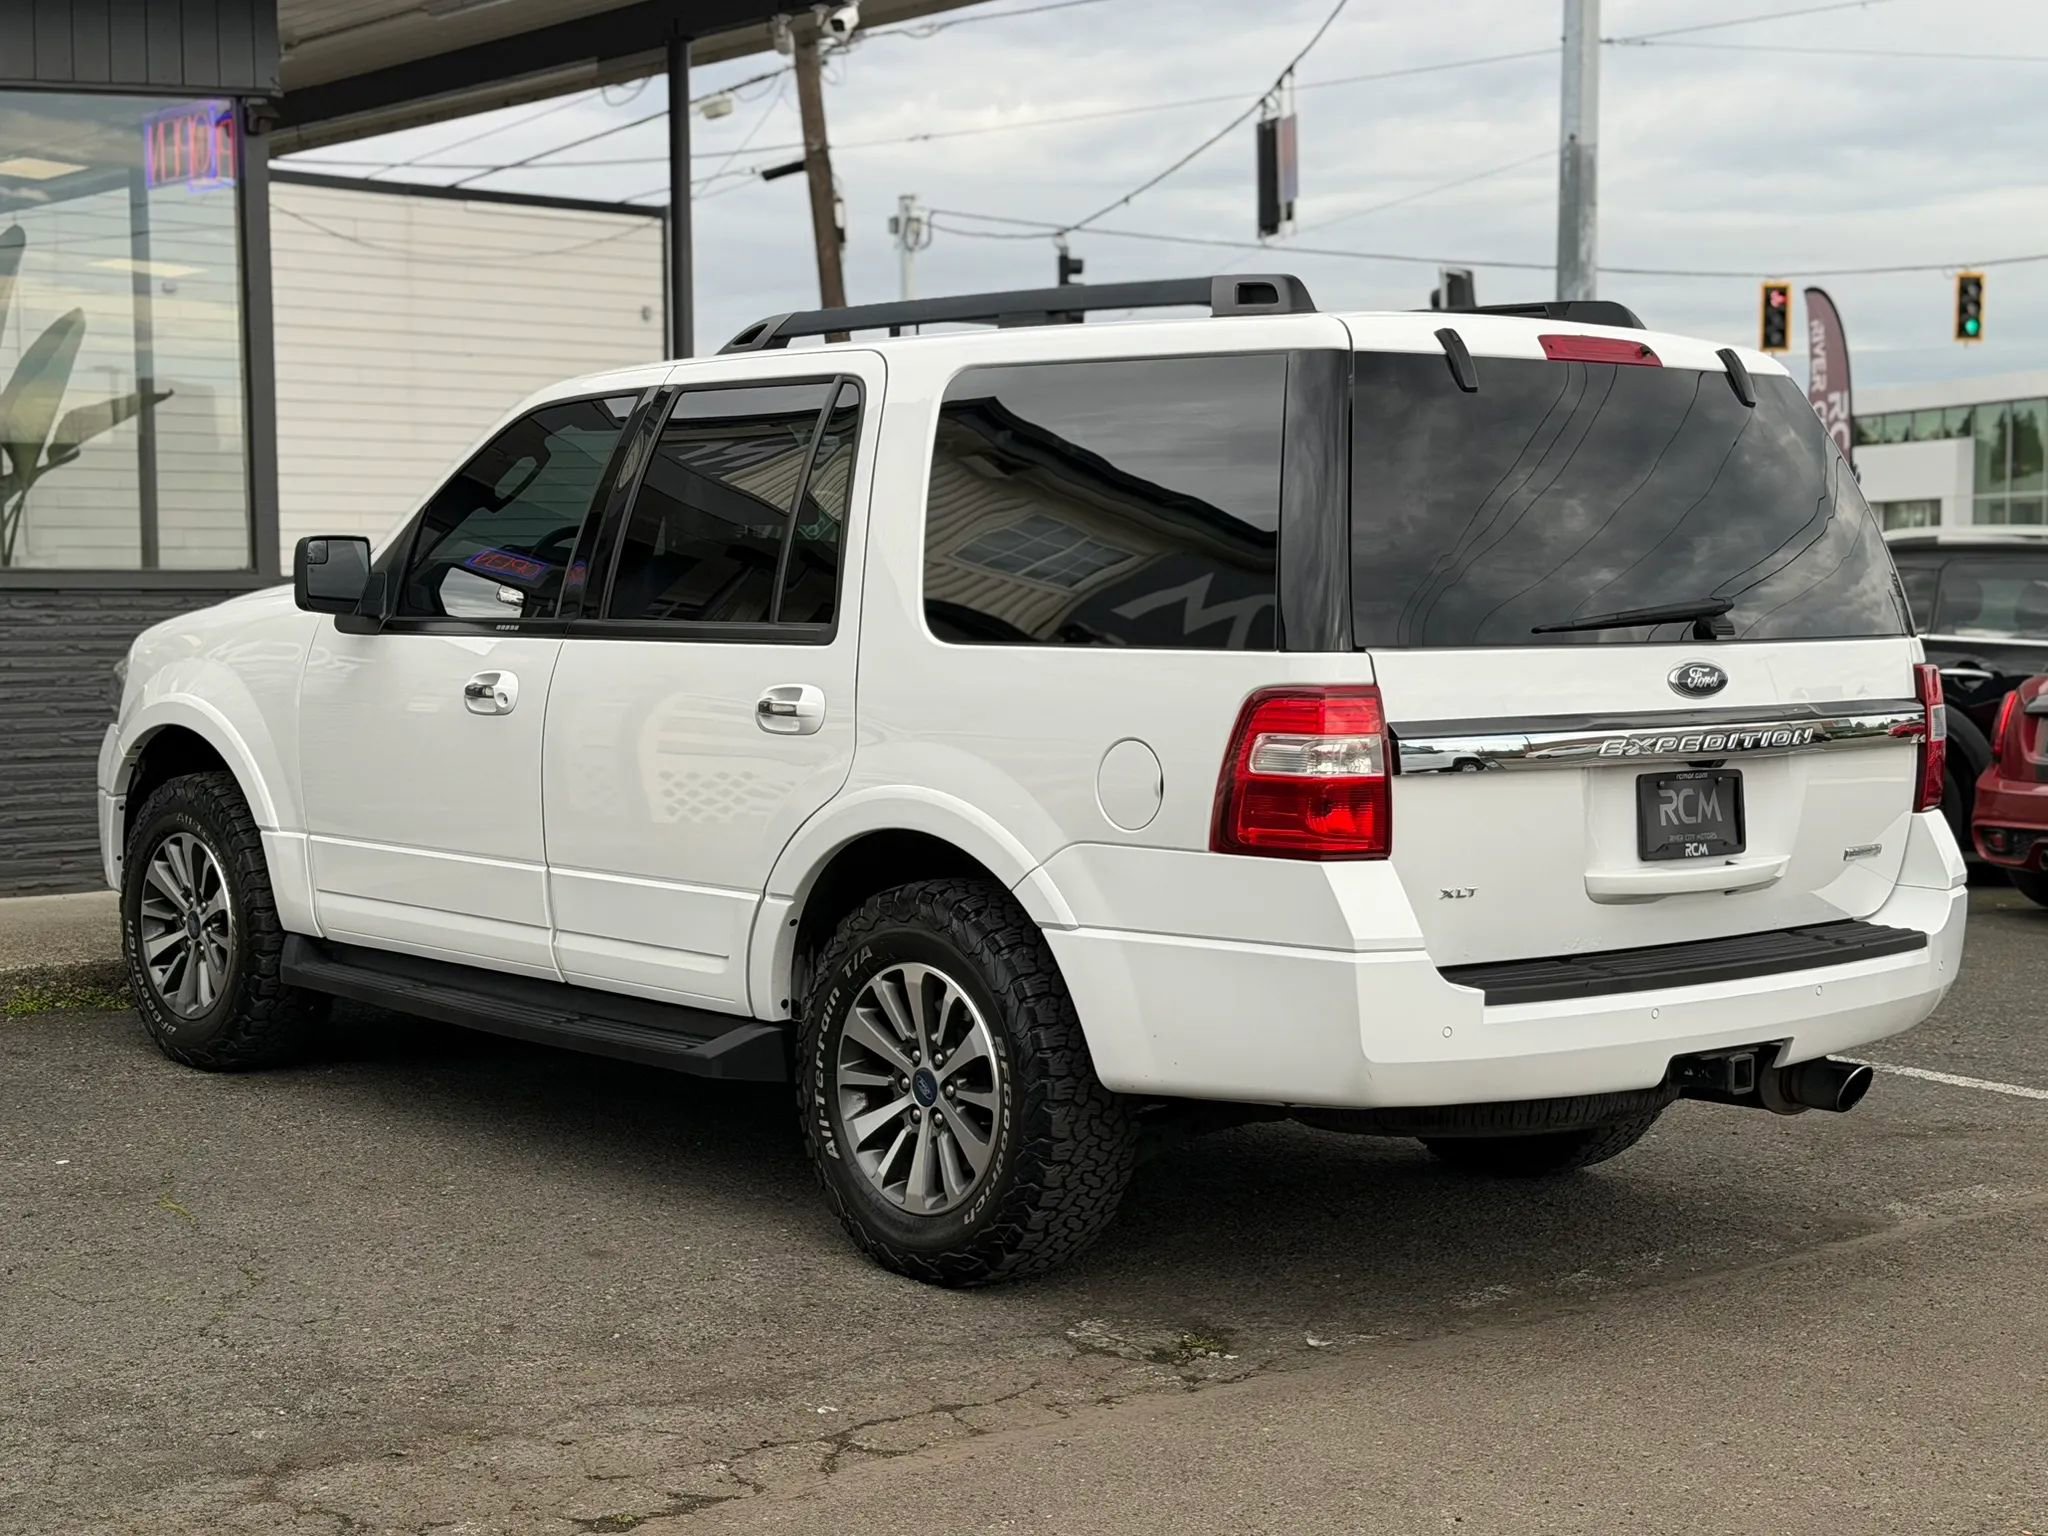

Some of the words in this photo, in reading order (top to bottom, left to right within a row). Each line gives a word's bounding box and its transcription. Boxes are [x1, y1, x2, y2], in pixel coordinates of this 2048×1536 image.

[1810, 319, 1828, 393] RIVER
[1687, 666, 1720, 689] Ford
[1598, 727, 1814, 757] EXPEDITION
[1658, 786, 1723, 826] RCM
[1685, 842, 1709, 857] RCM
[1439, 886, 1479, 901] XLT
[815, 986, 842, 1161] All-Terrain
[841, 944, 873, 980] T/A
[963, 1035, 1013, 1226] BFGoodrich
